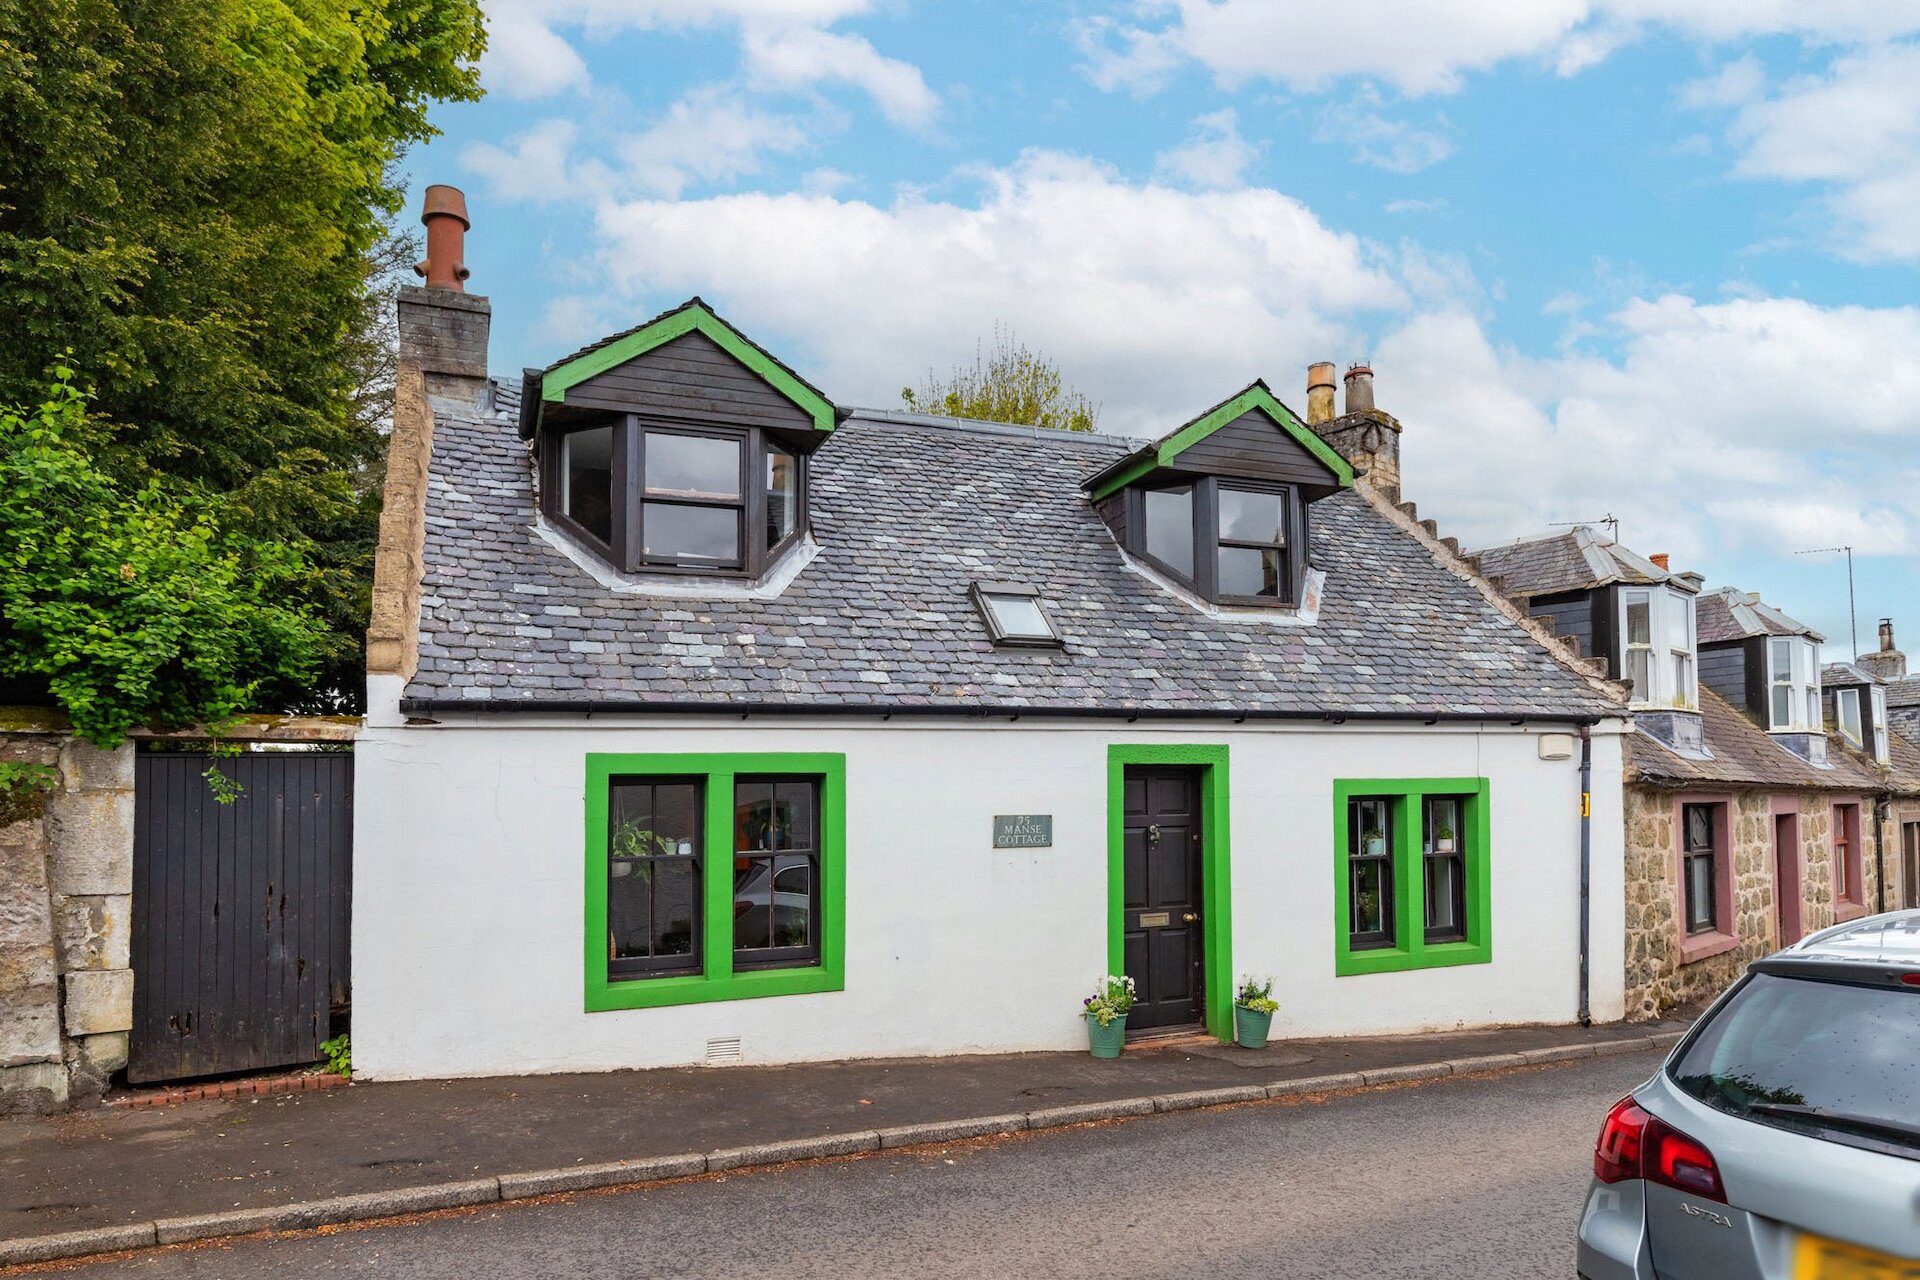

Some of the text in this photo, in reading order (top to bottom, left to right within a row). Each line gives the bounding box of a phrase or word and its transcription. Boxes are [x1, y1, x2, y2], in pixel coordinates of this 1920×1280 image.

[1017, 816, 1030, 825] 75
[1004, 825, 1042, 834] MANSE
[998, 834, 1048, 844] COTTAGE
[1680, 1202, 1732, 1228] ASTRA
